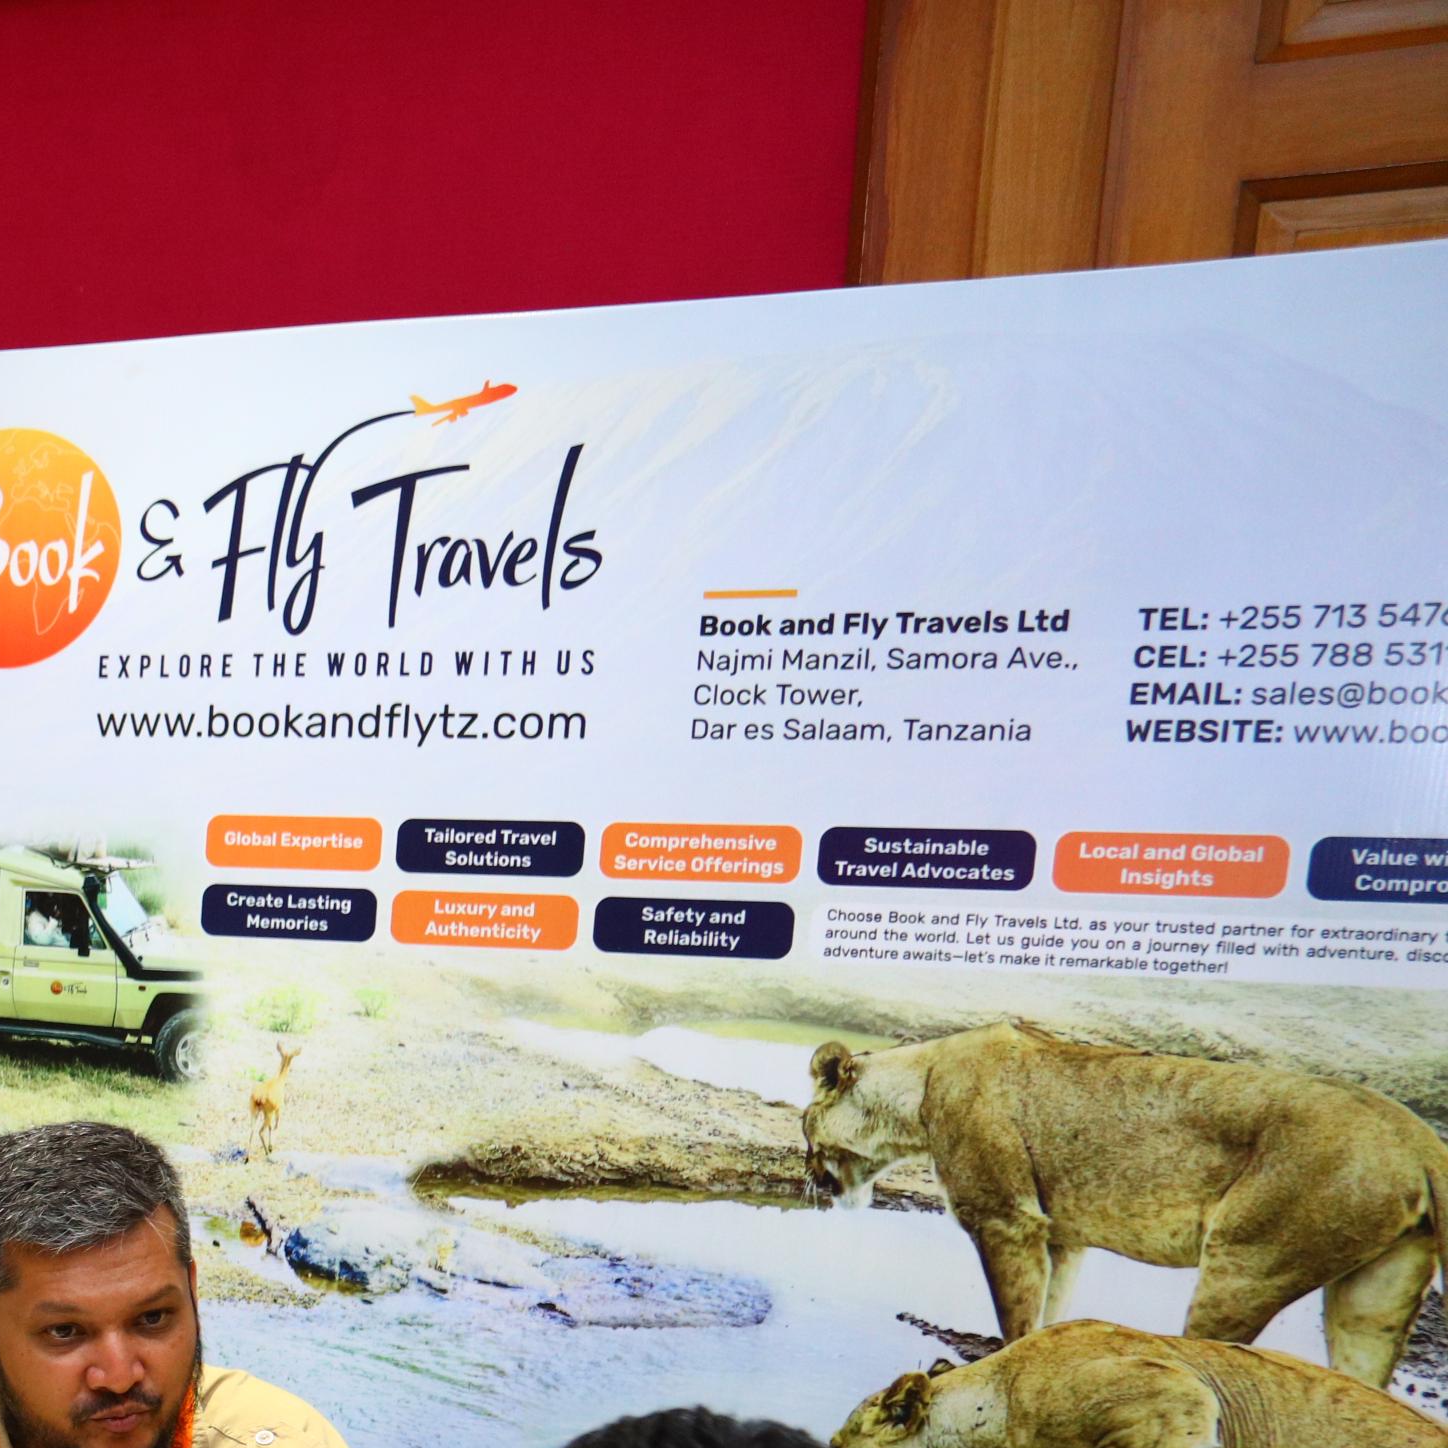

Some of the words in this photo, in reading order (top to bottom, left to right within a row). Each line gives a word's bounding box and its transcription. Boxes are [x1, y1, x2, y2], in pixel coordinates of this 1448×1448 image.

[137, 499, 184, 582] &
[204, 440, 344, 637] Fly
[351, 444, 603, 628] Travels
[700, 614, 771, 636] Book
[779, 613, 835, 635] and
[843, 613, 888, 640] Fly
[896, 610, 1008, 634] Travels
[1017, 609, 1070, 633] Ltd
[1139, 607, 1209, 631] TEL:
[1219, 605, 1301, 630] +255
[1313, 604, 1367, 629] 713
[98, 652, 234, 680] EXPLORE
[253, 652, 306, 678] THE
[328, 651, 434, 678] WORLD
[454, 650, 537, 677] WITH
[557, 649, 596, 676] US
[697, 649, 772, 676] Najmi
[782, 648, 876, 673] Manzil,
[887, 647, 997, 670] Samora
[1007, 646, 1078, 671] Ave.,
[1134, 645, 1207, 669] CEL:
[1218, 644, 1299, 668] +255
[1311, 643, 1373, 667] 788
[1384, 642, 1448, 667] 531
[694, 684, 767, 706] Clock
[777, 684, 863, 708] Tower,
[1130, 682, 1242, 706] EMAIL:
[97, 703, 586, 749] www.bookandflytz.com
[691, 719, 736, 740] Dar
[744, 722, 774, 740] es
[783, 718, 892, 742] Salaam,
[904, 718, 1032, 742] Tanzania
[1127, 719, 1283, 743] WEBSITE:
[224, 831, 277, 849] Global
[280, 832, 363, 851] Expertise
[424, 828, 496, 845] Tailored
[500, 829, 557, 847] Travel
[625, 832, 777, 852] Comprehensive
[864, 837, 989, 857] Sustainable
[445, 850, 531, 868] Solutions
[1079, 842, 1139, 861] Local
[1143, 844, 1187, 862] and
[1191, 845, 1264, 863] Global
[1352, 848, 1419, 866] Value
[614, 855, 688, 872] Service
[691, 856, 784, 877] Offerings
[835, 860, 898, 878] Travel
[902, 862, 1015, 882] Advocates
[1120, 868, 1214, 889] Insights
[226, 892, 283, 910] Create
[287, 894, 352, 915] Lasting
[434, 900, 497, 921] Luxury
[500, 901, 535, 918] and
[246, 913, 328, 932] Memories
[641, 906, 704, 926] Safety
[709, 908, 746, 926] and
[827, 909, 882, 923] Choose
[889, 911, 925, 924] Book
[931, 912, 959, 926] and
[966, 913, 988, 929] Fly
[994, 914, 1047, 929] Travels
[1089, 919, 1107, 931] as
[1113, 922, 1150, 937] your
[1156, 919, 1215, 935] trusted
[1222, 923, 1284, 941] partner
[1291, 924, 1314, 939] for
[1321, 927, 1438, 945] extraordinary
[425, 921, 541, 942] Authenticity
[643, 929, 740, 951] Reliability
[825, 927, 877, 940] around
[884, 929, 908, 942] the
[914, 930, 959, 944] world.
[966, 932, 990, 945] Let
[997, 935, 1014, 946] us
[1021, 934, 1064, 950] guide
[1071, 937, 1099, 951] you
[1106, 939, 1125, 950] on
[1132, 941, 1141, 951] a
[1147, 939, 1209, 955] journey
[1216, 940, 1255, 955] filled
[1263, 943, 1299, 958] with
[823, 945, 898, 960] adventure
[999, 952, 1041, 966] make
[1044, 953, 1055, 967] it
[1059, 955, 1147, 970] remarkable
[1153, 958, 1228, 975] together!
